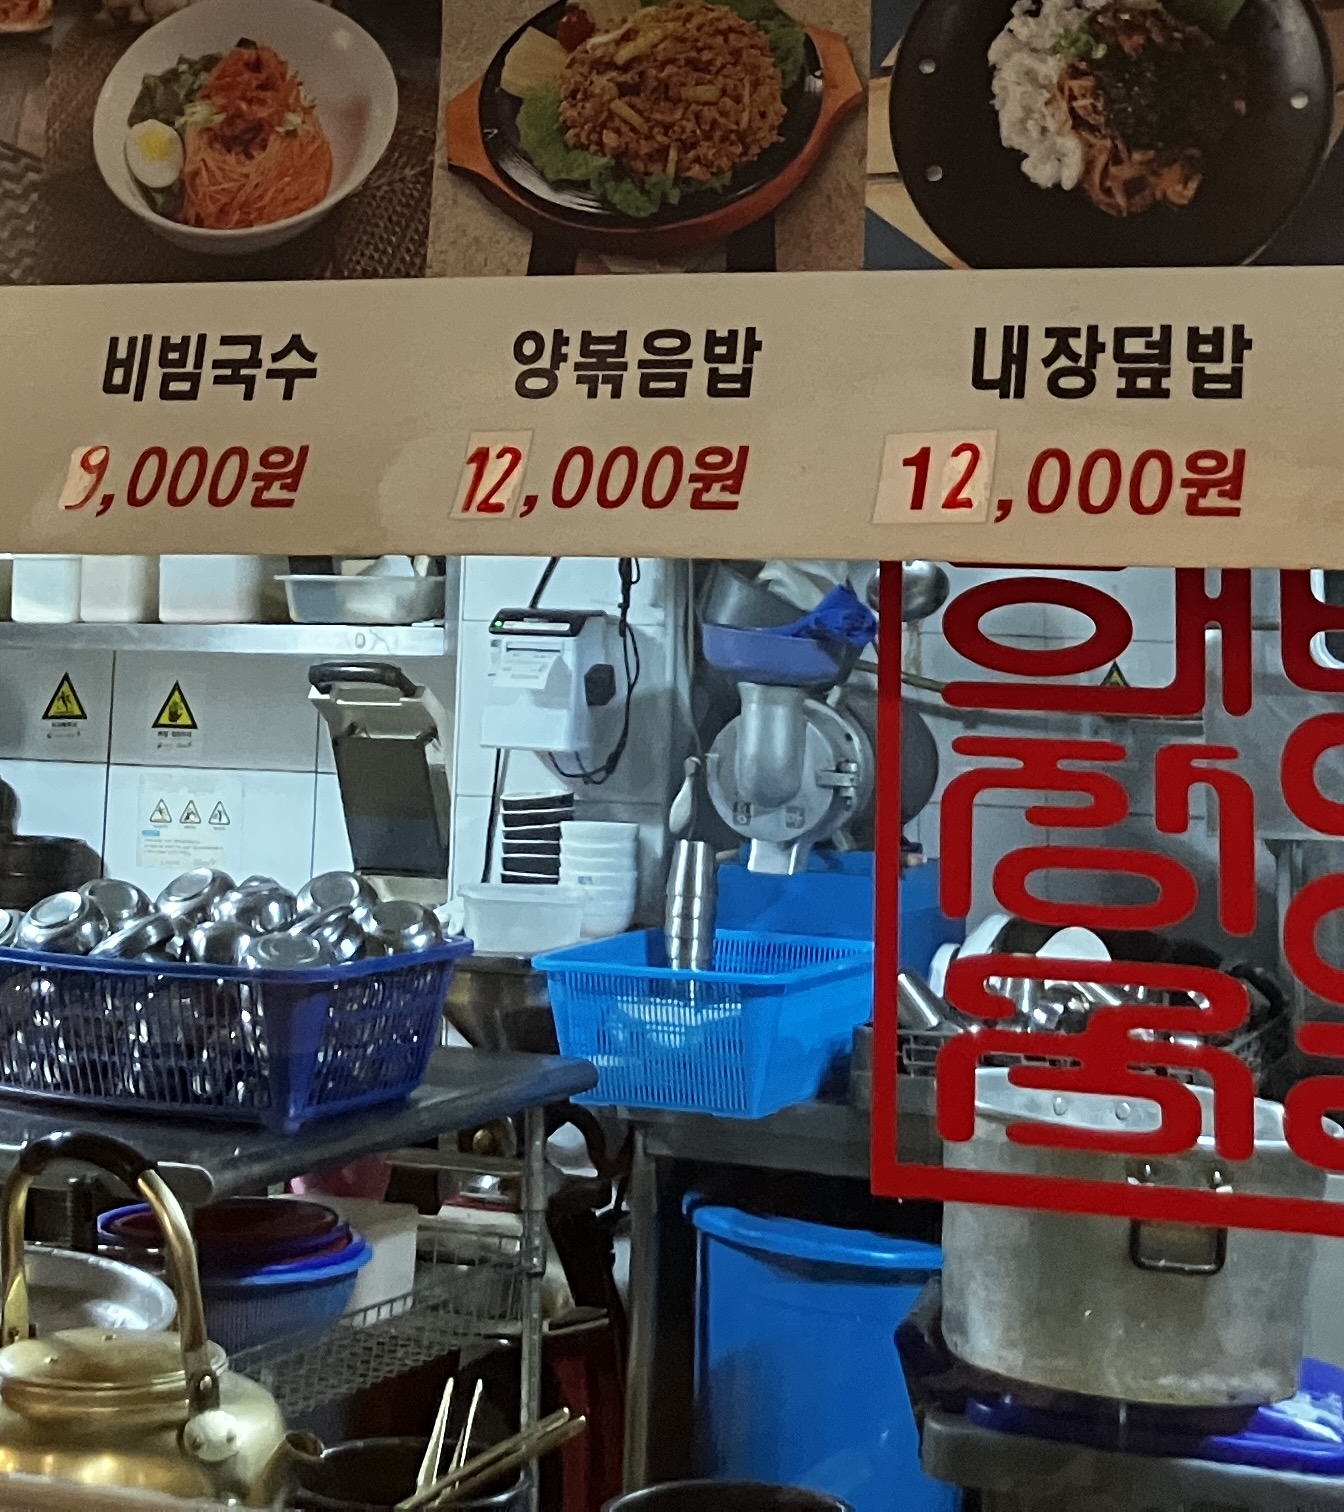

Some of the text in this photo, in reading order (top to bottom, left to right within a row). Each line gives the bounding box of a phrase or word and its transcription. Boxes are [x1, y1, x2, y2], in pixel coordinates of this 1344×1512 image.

[101, 332, 320, 403] 비빔국수
[511, 324, 764, 401] 양볶음밥
[970, 322, 1254, 402] 내장덮밥
[63, 443, 311, 517] 9,000원
[460, 443, 751, 520] 12,000원
[900, 442, 1248, 524] 12,000원
